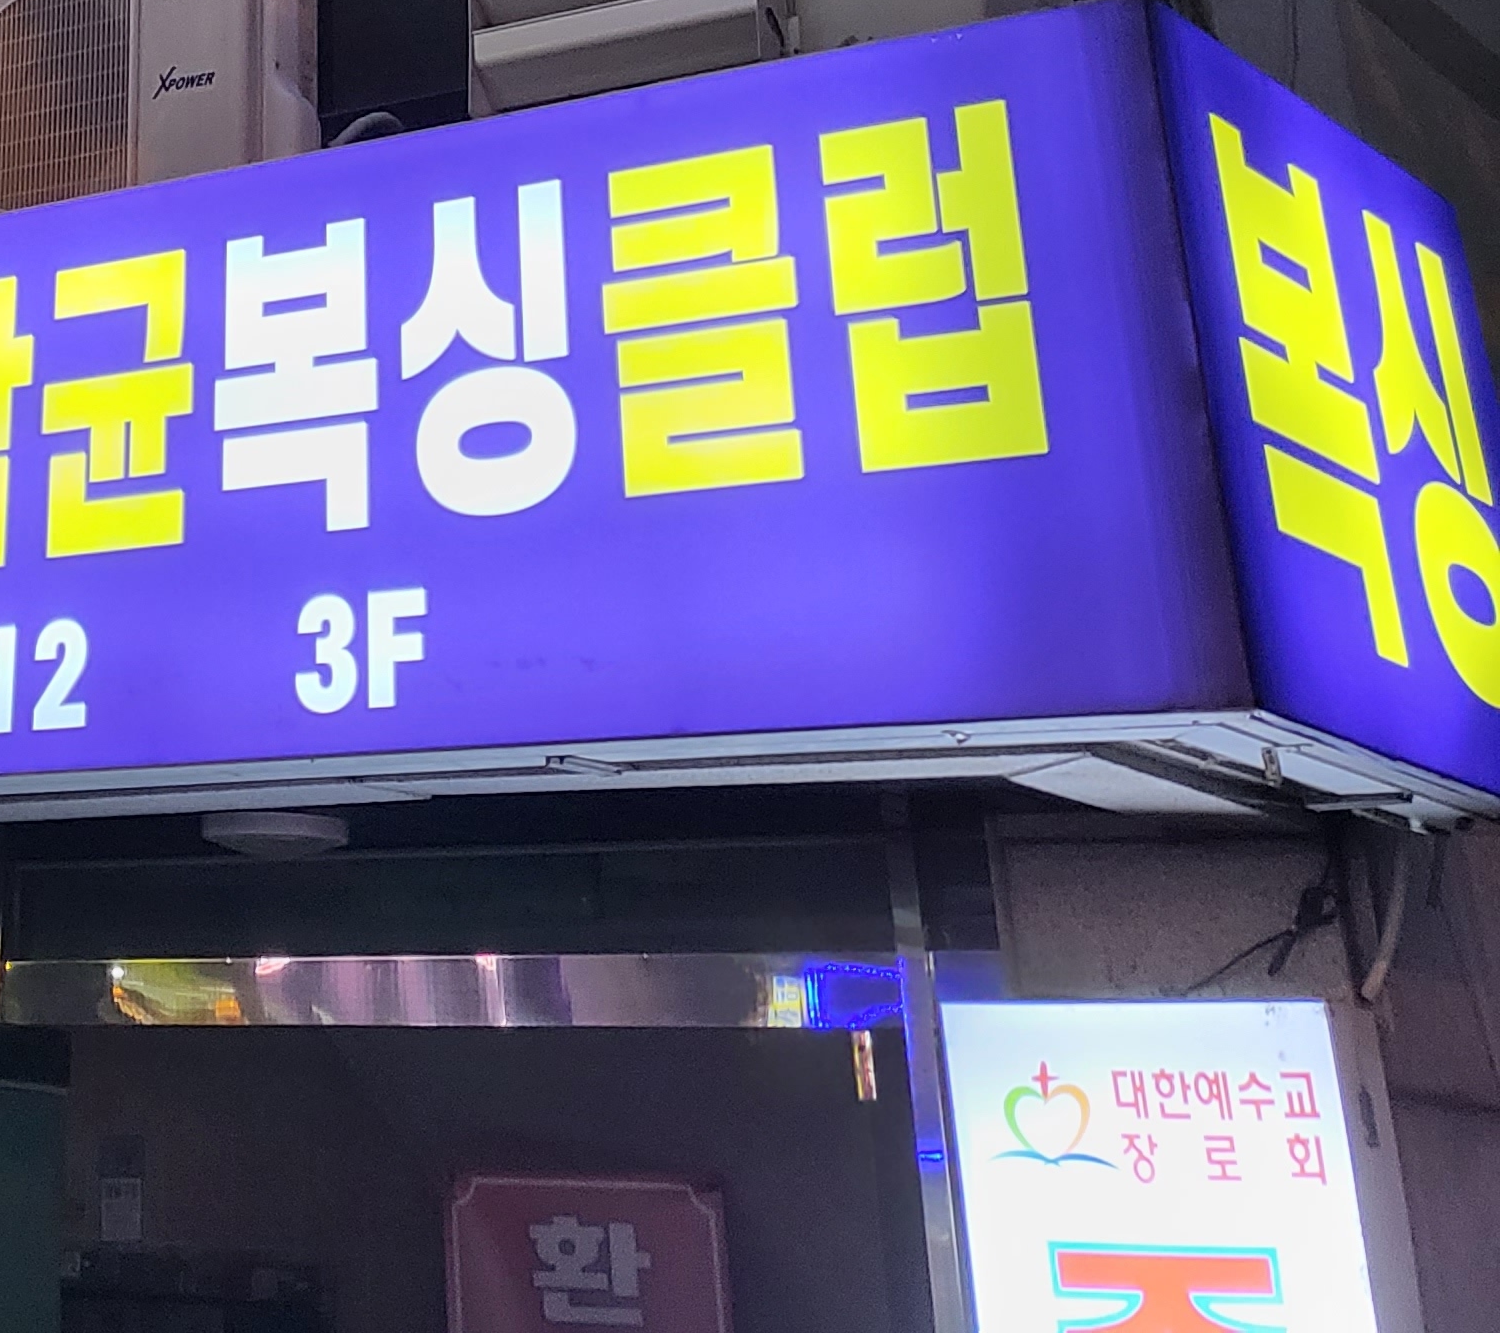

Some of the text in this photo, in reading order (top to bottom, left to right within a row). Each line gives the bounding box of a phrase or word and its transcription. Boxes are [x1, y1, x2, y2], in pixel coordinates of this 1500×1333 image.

[1208, 112, 1500, 711] 복싱
[294, 585, 428, 715] 3F
[1111, 1067, 1322, 1122] 대한예수교
[528, 1213, 653, 1327] 환
